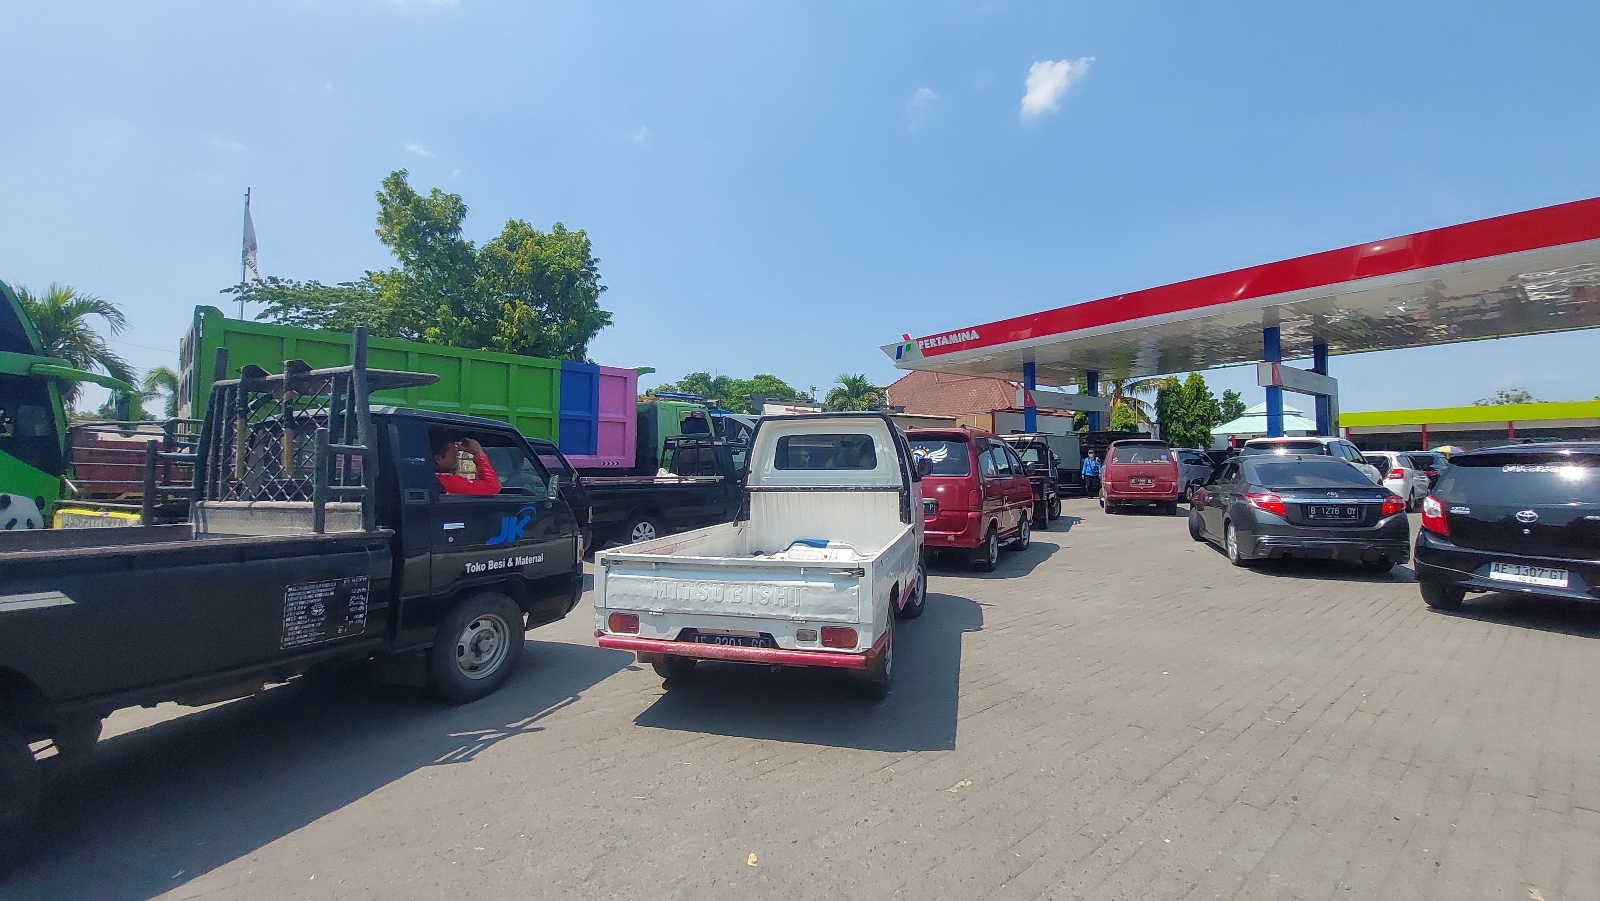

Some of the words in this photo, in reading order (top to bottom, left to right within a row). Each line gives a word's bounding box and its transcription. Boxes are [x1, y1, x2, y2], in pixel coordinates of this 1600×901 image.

[918, 330, 980, 349] PERTAMINA
[1310, 507, 1316, 515] B
[1321, 507, 1340, 515] 1276
[486, 515, 531, 546] JK
[465, 560, 486, 574] Toko
[488, 557, 506, 571] Besi
[507, 557, 514, 567] &
[515, 553, 544, 567] Material
[1493, 563, 1509, 573] AE
[1514, 565, 1545, 577] 1307
[1549, 569, 1566, 580] GT
[654, 581, 801, 607] MITSUBISHI
